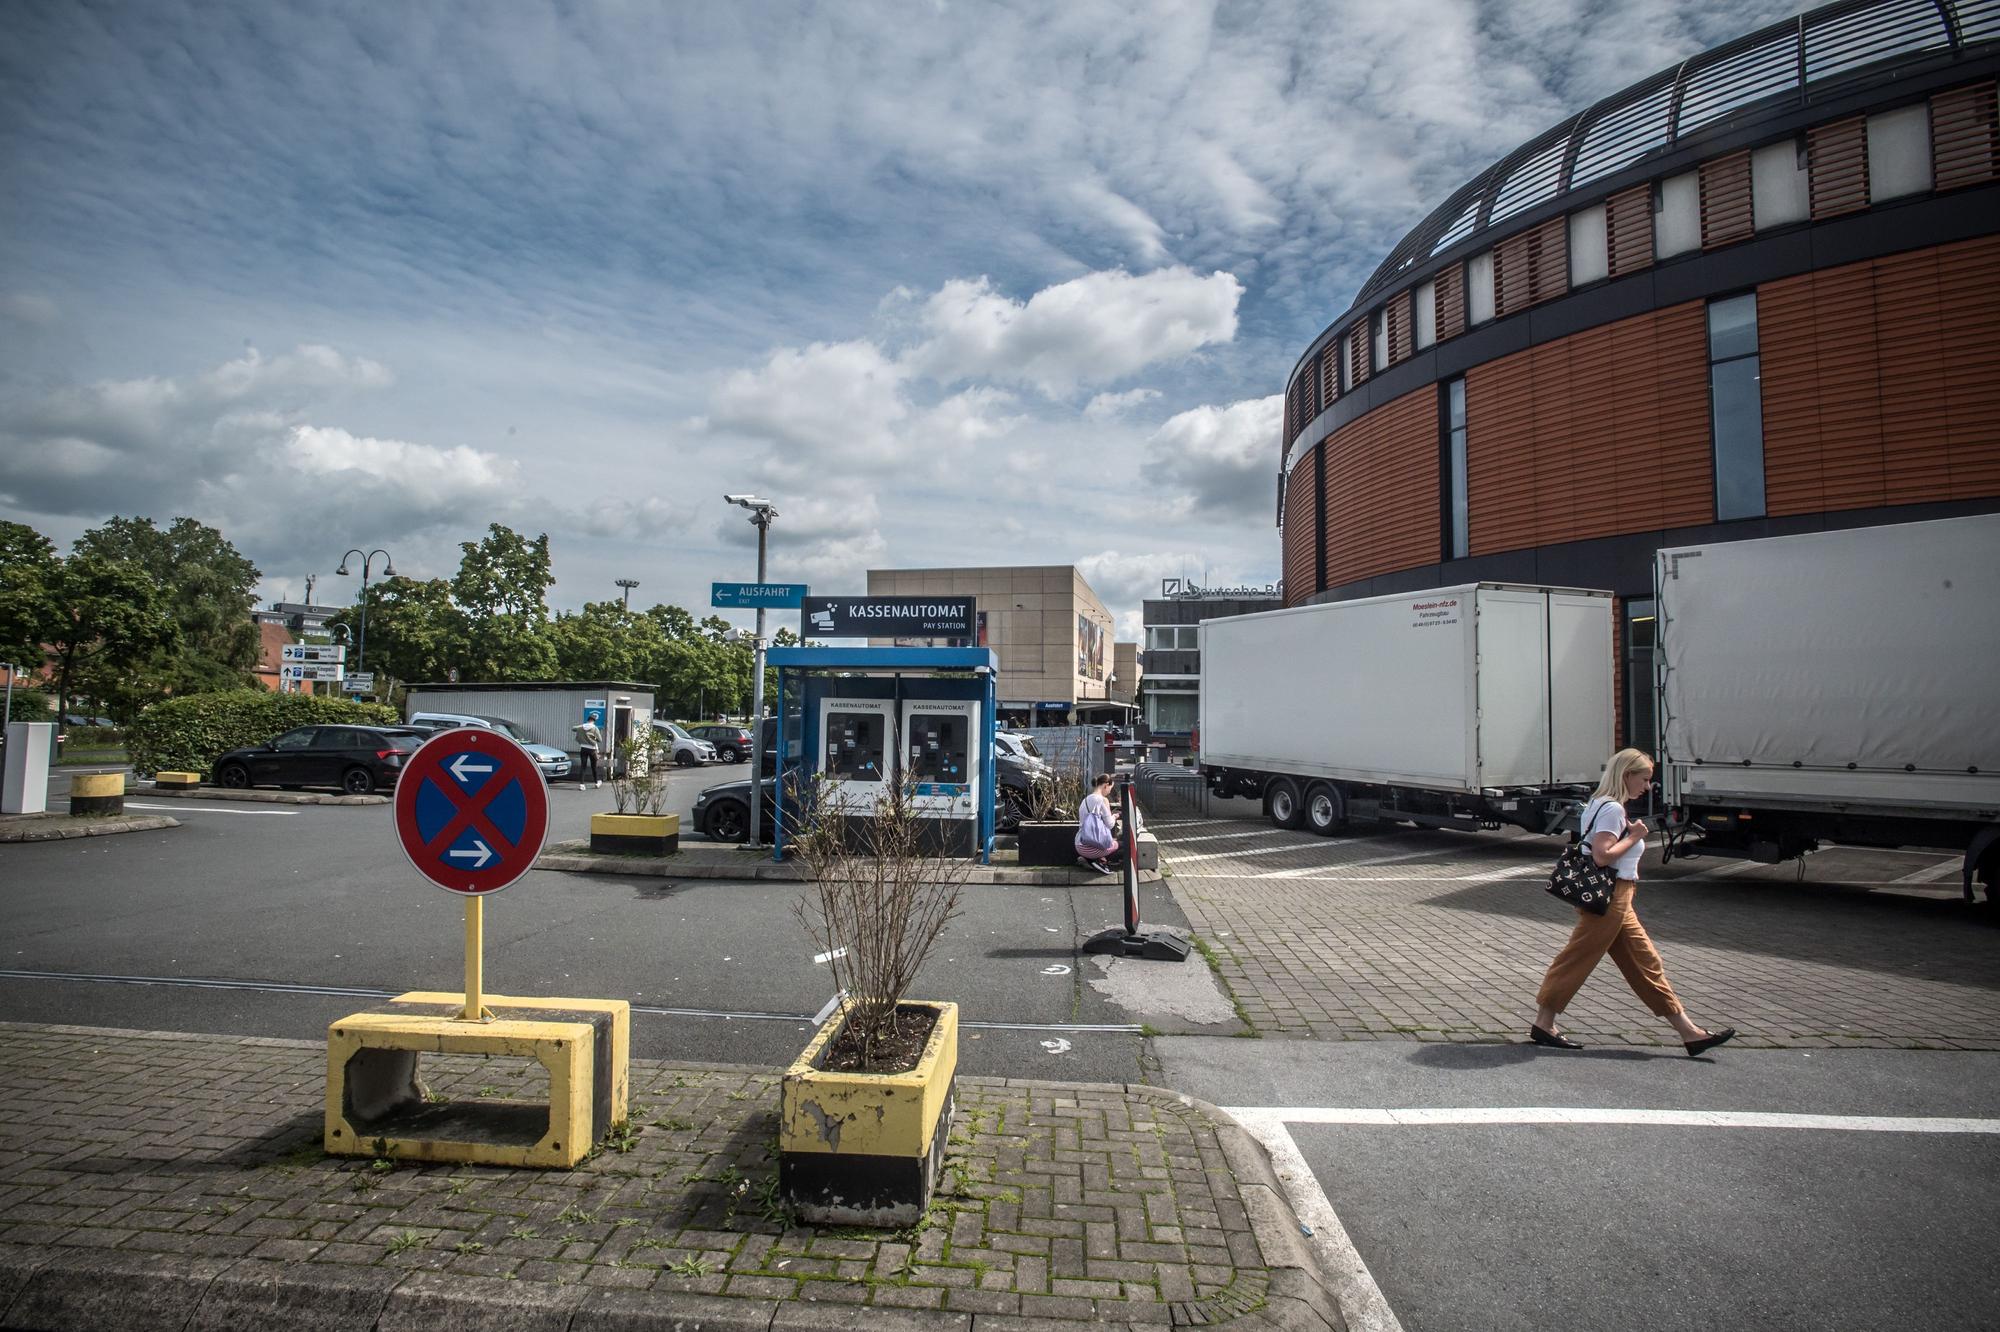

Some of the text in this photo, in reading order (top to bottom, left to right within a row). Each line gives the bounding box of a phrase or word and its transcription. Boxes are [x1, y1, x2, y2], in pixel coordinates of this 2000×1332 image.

[739, 587, 791, 598] AUSFAHRT
[1190, 584, 1258, 597] Deutsche
[849, 605, 966, 618] KASSENAUTOMAT
[938, 622, 966, 630] STATION
